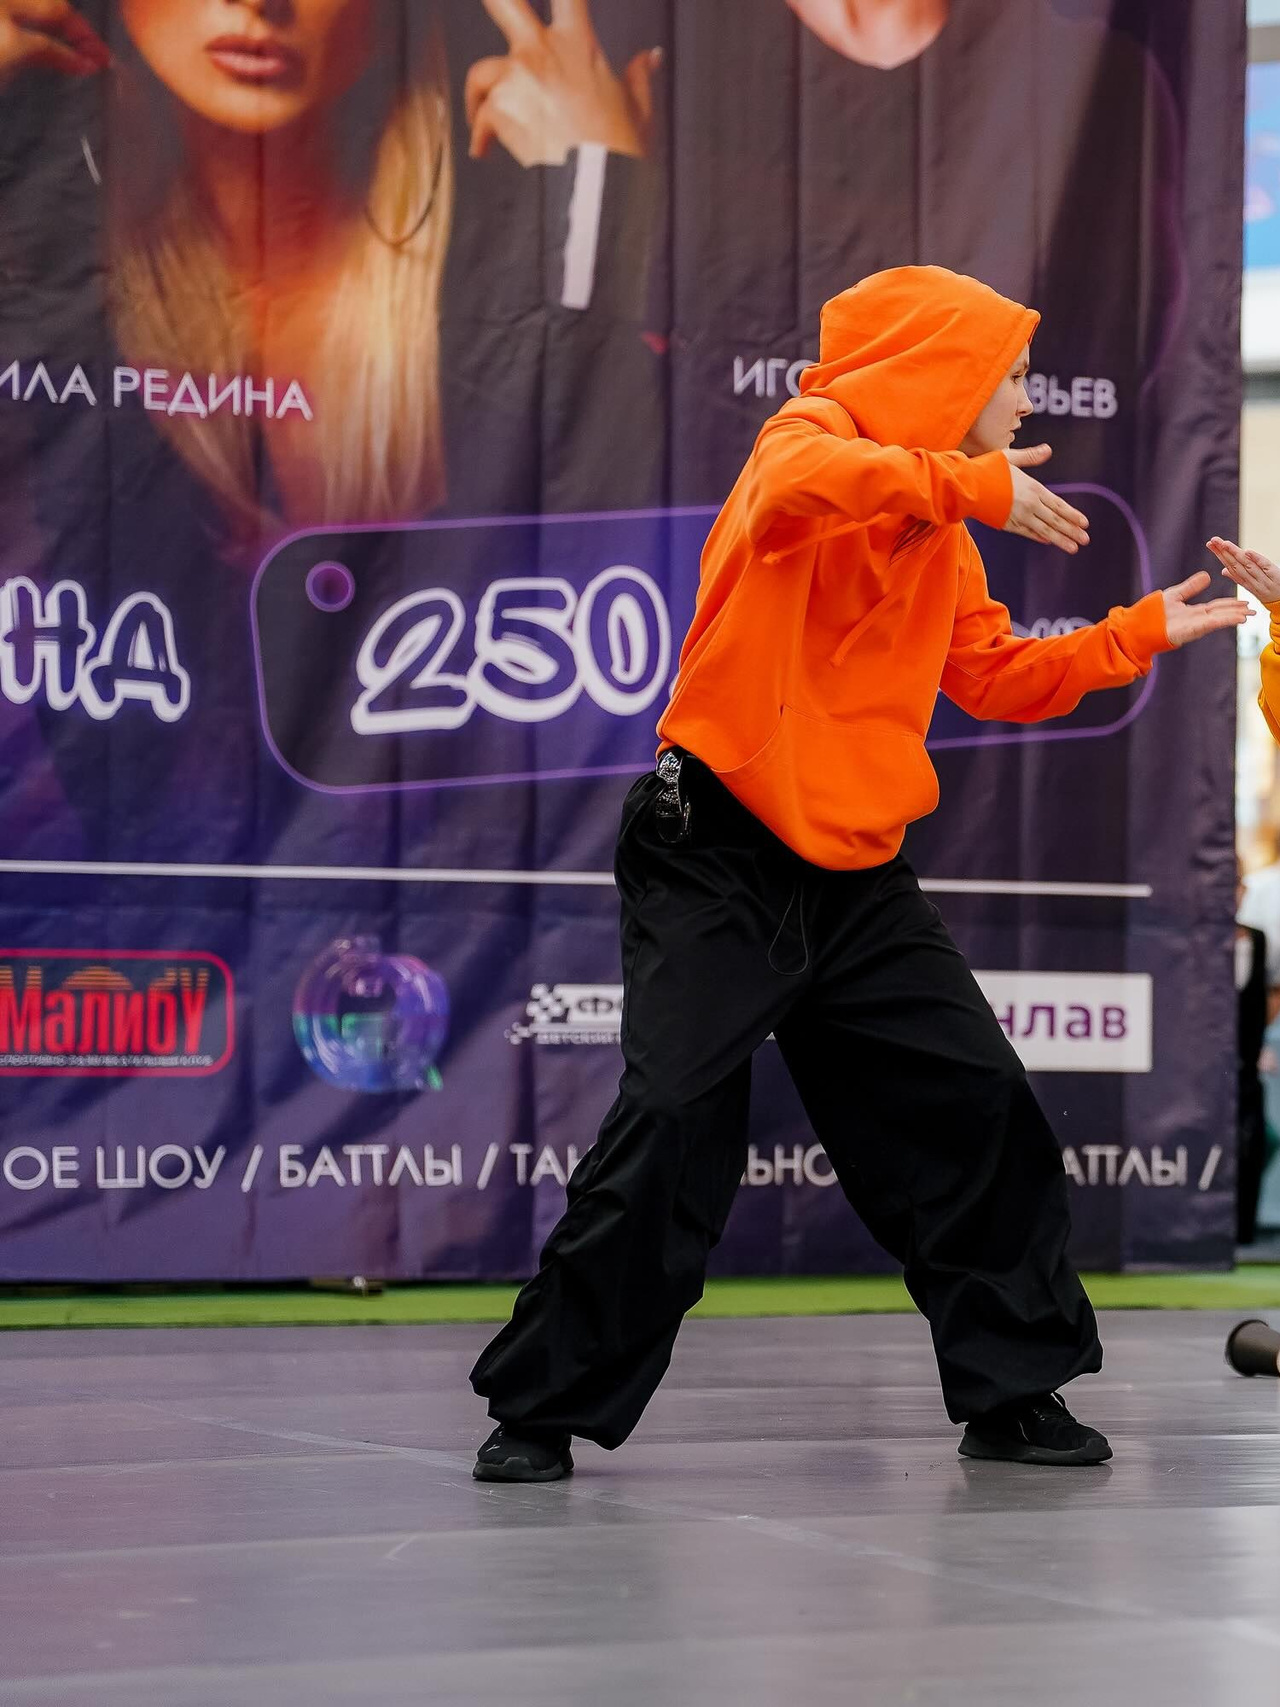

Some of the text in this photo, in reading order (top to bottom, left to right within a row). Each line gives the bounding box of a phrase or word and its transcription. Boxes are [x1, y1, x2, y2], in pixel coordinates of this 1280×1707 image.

[113, 366, 313, 420] РЕДИНА
[733, 355, 1118, 419] ИГО ВЬЕВ
[997, 1004, 1127, 1039] нлав
[3, 1145, 80, 1190] ОЕ
[96, 1144, 226, 1189] ШОУ
[279, 1143, 462, 1188] БАТТЛЫ
[740, 1143, 839, 1187] ЬНО
[1062, 1144, 1189, 1187] АТТЛЫ
